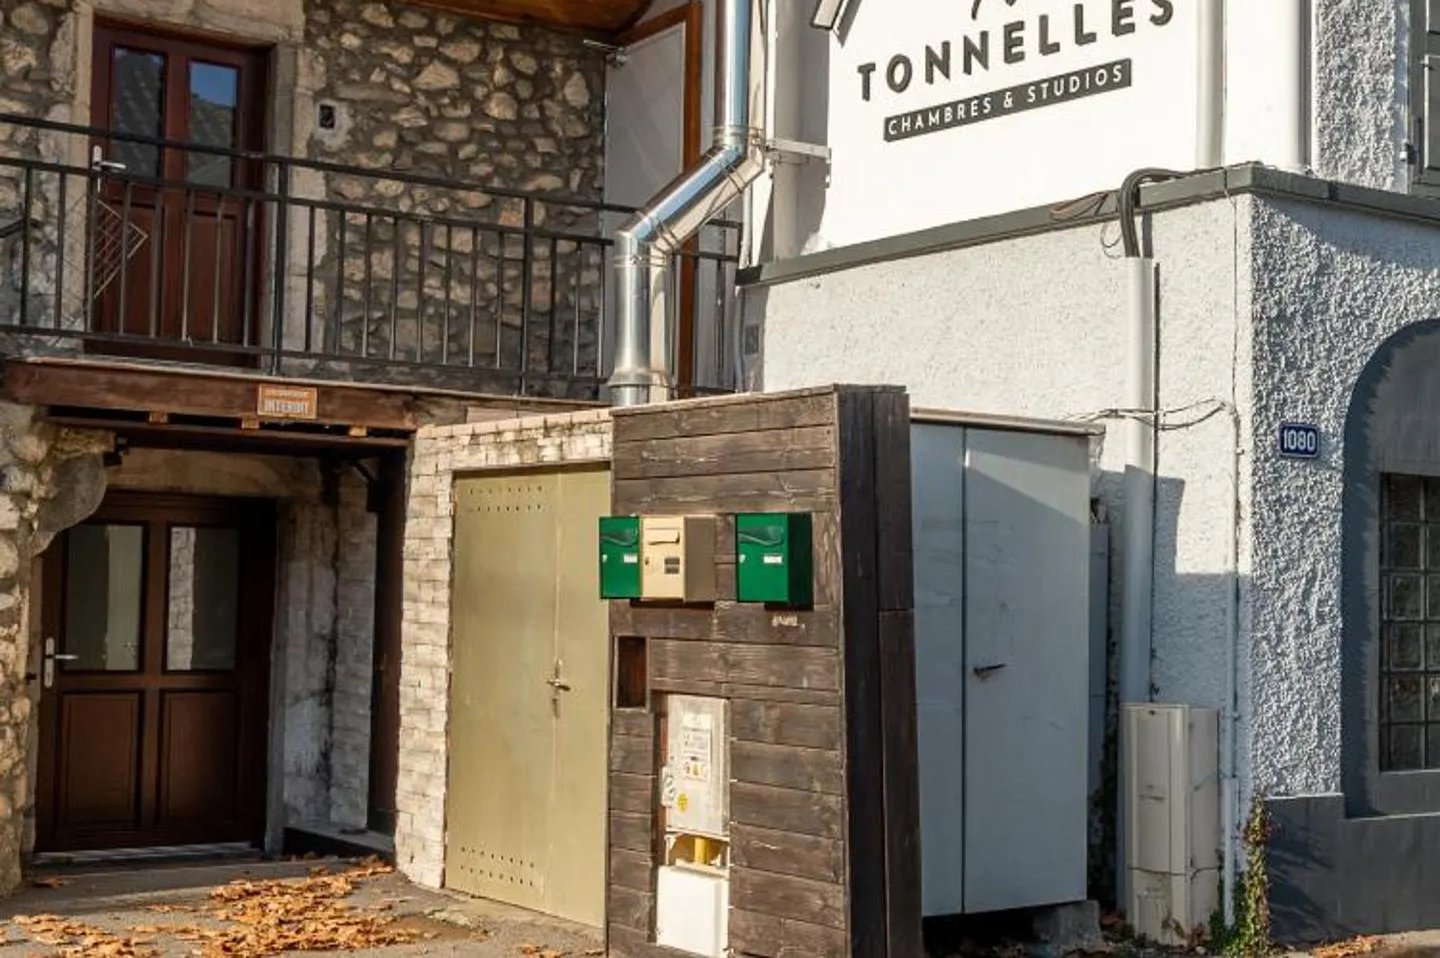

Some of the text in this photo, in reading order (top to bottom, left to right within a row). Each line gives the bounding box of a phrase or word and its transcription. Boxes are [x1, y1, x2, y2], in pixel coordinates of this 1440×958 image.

[887, 63, 1123, 136] CHAMBRES & STUDIOS
[1283, 429, 1316, 452] 1080
